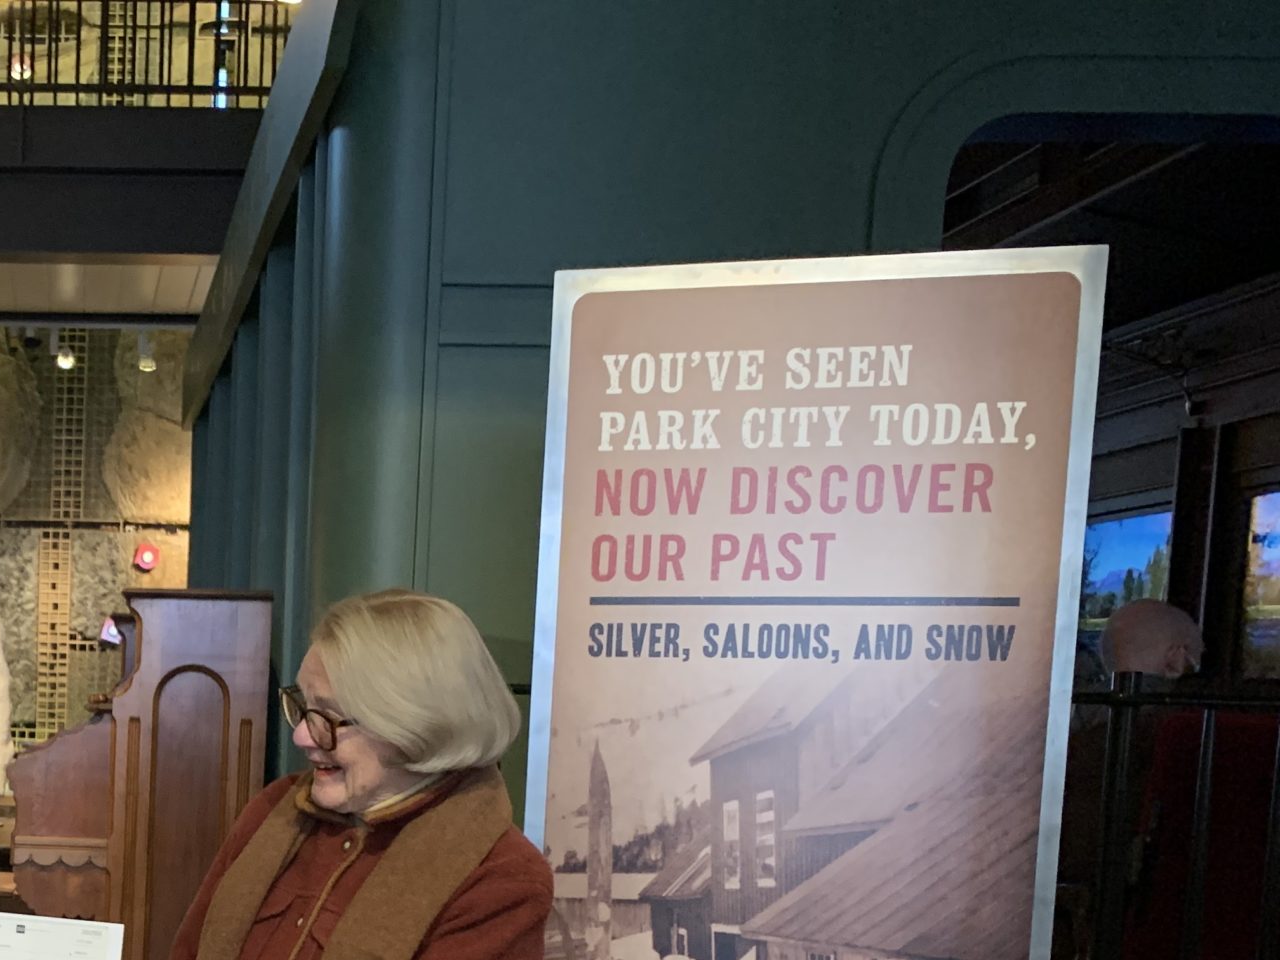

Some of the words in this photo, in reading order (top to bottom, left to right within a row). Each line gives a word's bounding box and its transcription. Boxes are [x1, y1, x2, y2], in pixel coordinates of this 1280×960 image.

[602, 349, 765, 394] YOU'VE
[785, 345, 913, 390] SEEN
[597, 409, 721, 451] PARK
[741, 405, 850, 449] CITY
[869, 401, 1036, 450] TODAY,
[594, 467, 707, 516] NOW
[730, 463, 994, 515] DISCOVER
[591, 533, 686, 582] OUR
[710, 532, 836, 582] PAST
[588, 622, 690, 662] SILVER,
[702, 622, 840, 664] SALOONS,
[853, 623, 913, 660] AND
[925, 624, 1016, 662] SNOW
